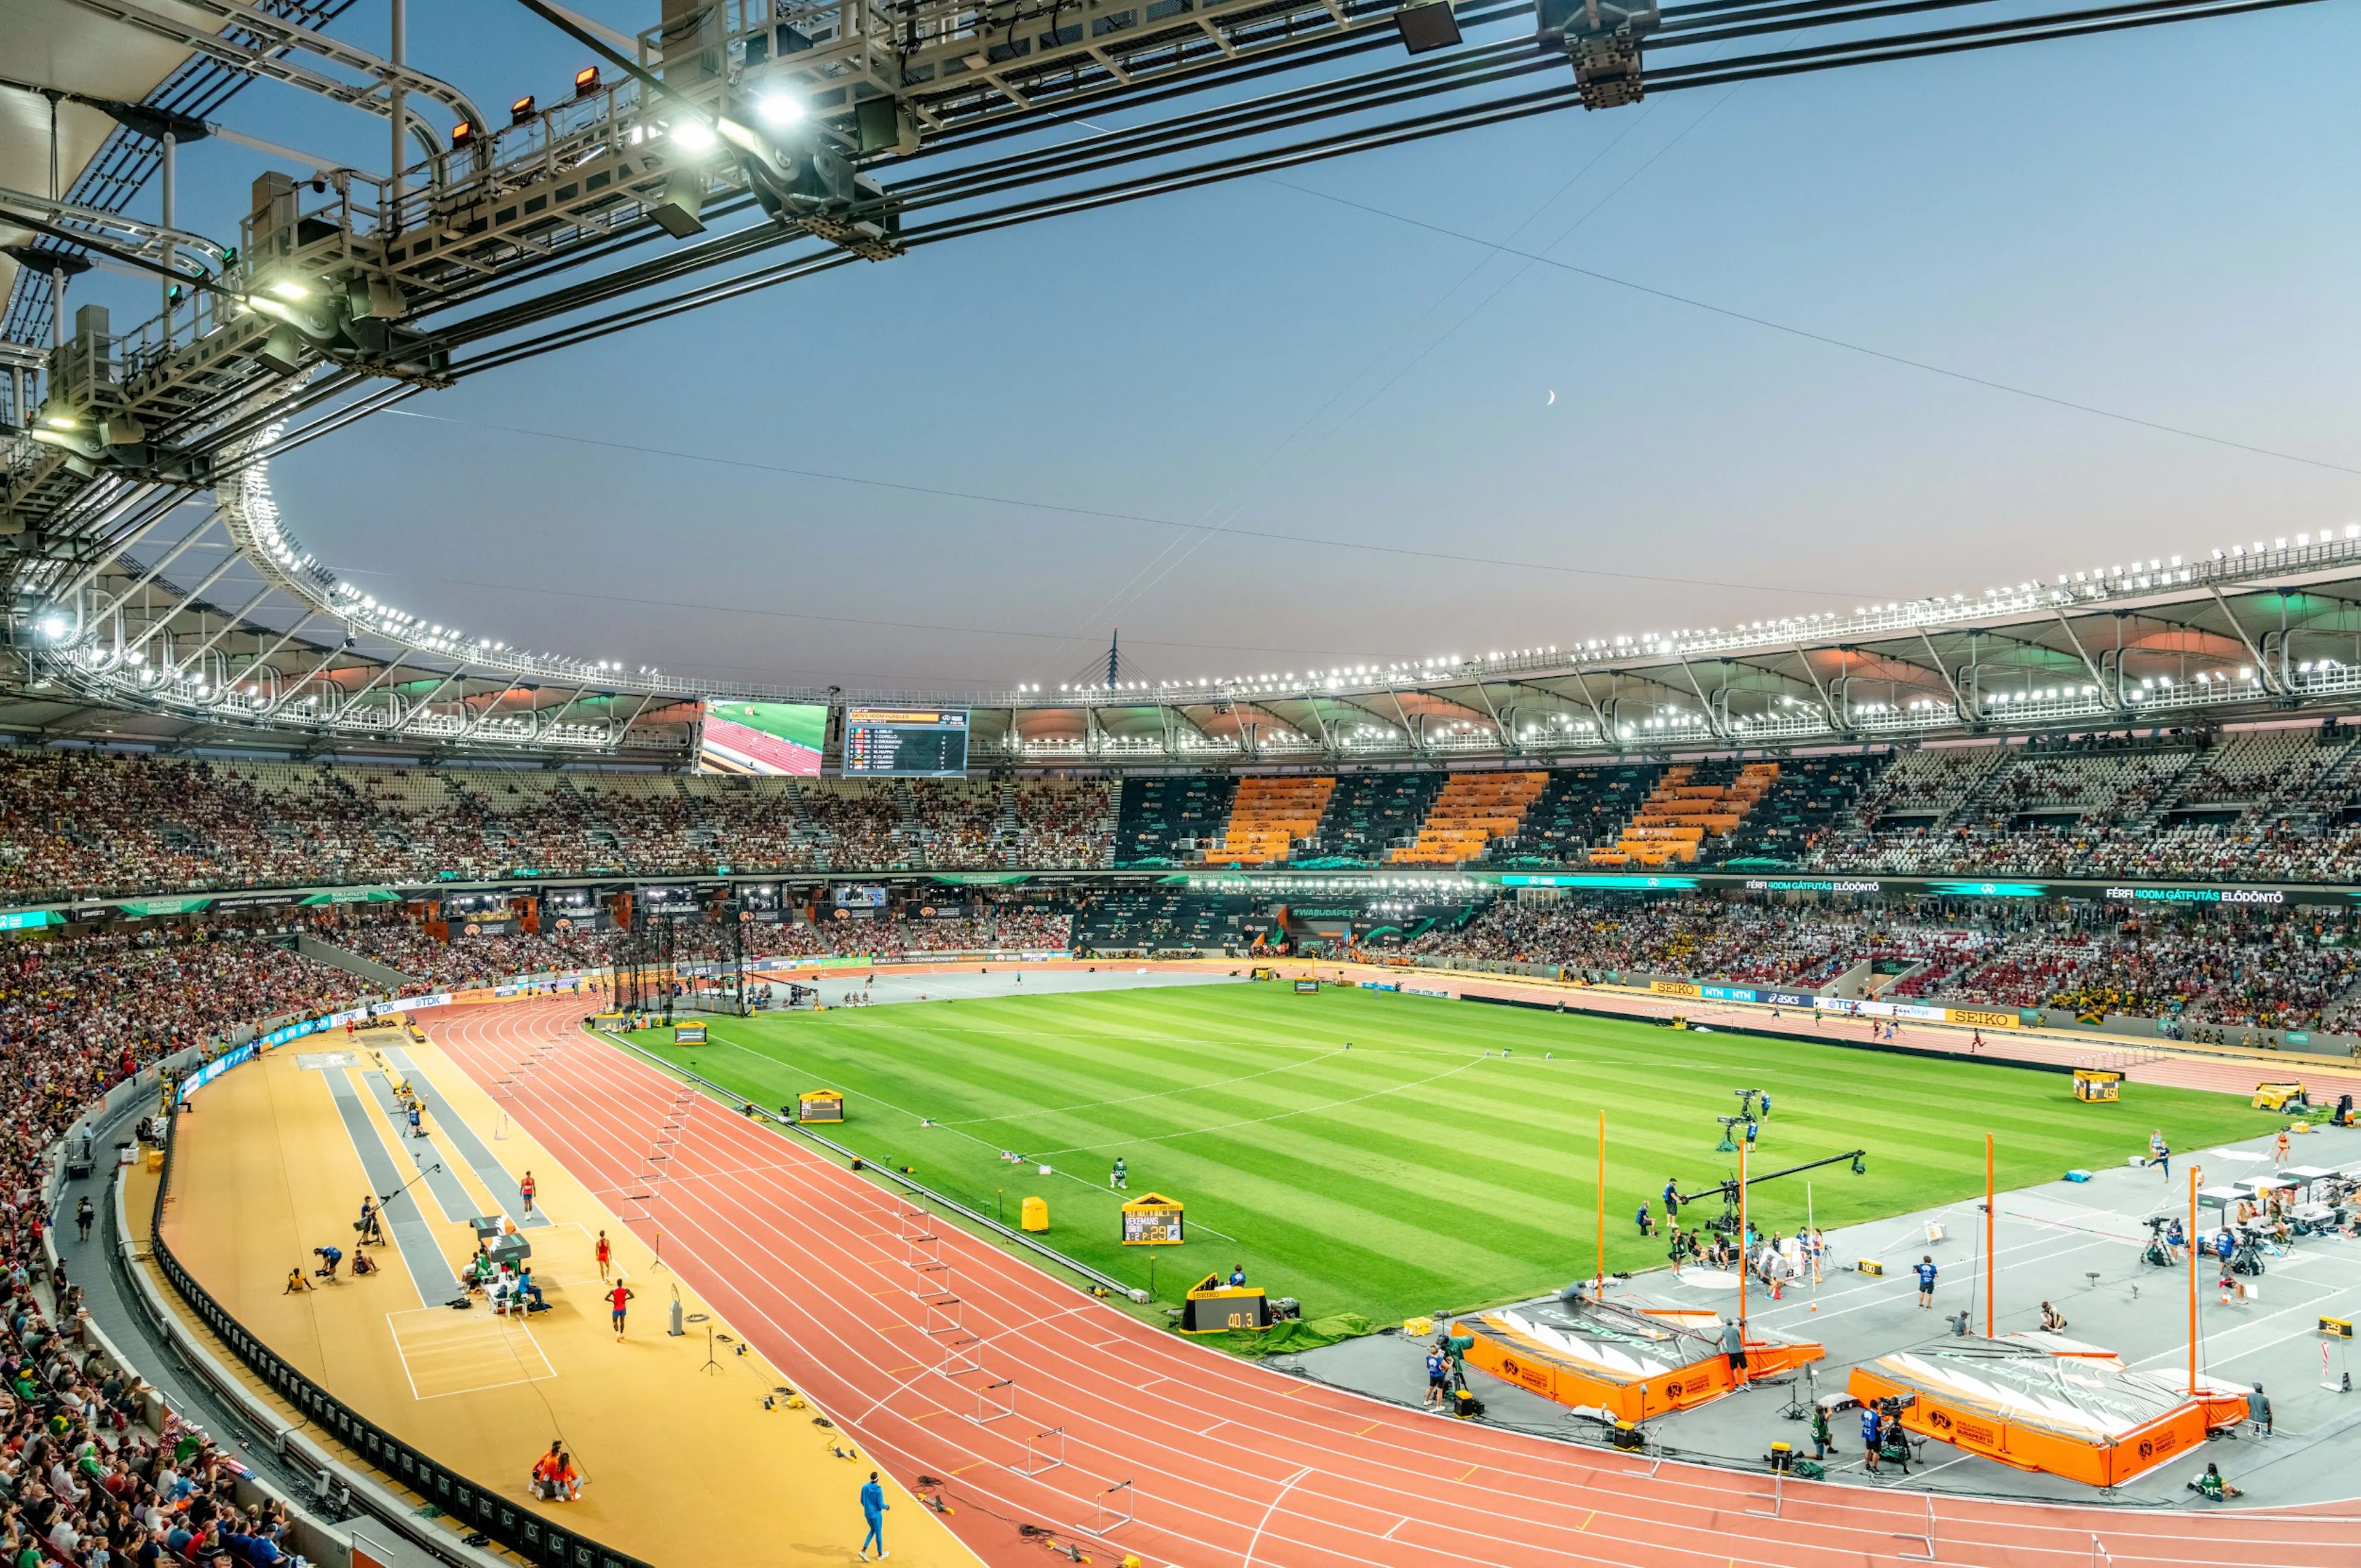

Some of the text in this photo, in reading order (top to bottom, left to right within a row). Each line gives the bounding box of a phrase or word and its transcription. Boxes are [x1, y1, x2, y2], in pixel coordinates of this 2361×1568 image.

[1747, 880, 1767, 889] FÉRFI
[1792, 881, 1832, 891] GÁTFUTÁS
[2106, 887, 2284, 903] FÉRFI 400M GÁTFUTÁS ELŐDÖNTŐ
[1658, 983, 1694, 995] SEIKO
[1705, 988, 1723, 997] NTN
[421, 995, 440, 1006] TDK
[1733, 991, 1750, 1000] NTN
[1778, 993, 1798, 1005] asics
[378, 1003, 394, 1014] TDK
[1836, 1000, 1862, 1011] TDK
[1955, 1011, 2007, 1025] SEIKO
[1125, 1217, 1158, 1226] VEKEMANS
[1228, 1312, 1253, 1328] 40.3
[2326, 1322, 2340, 1333] 29
[1956, 1428, 1986, 1441] BUDAPEST
